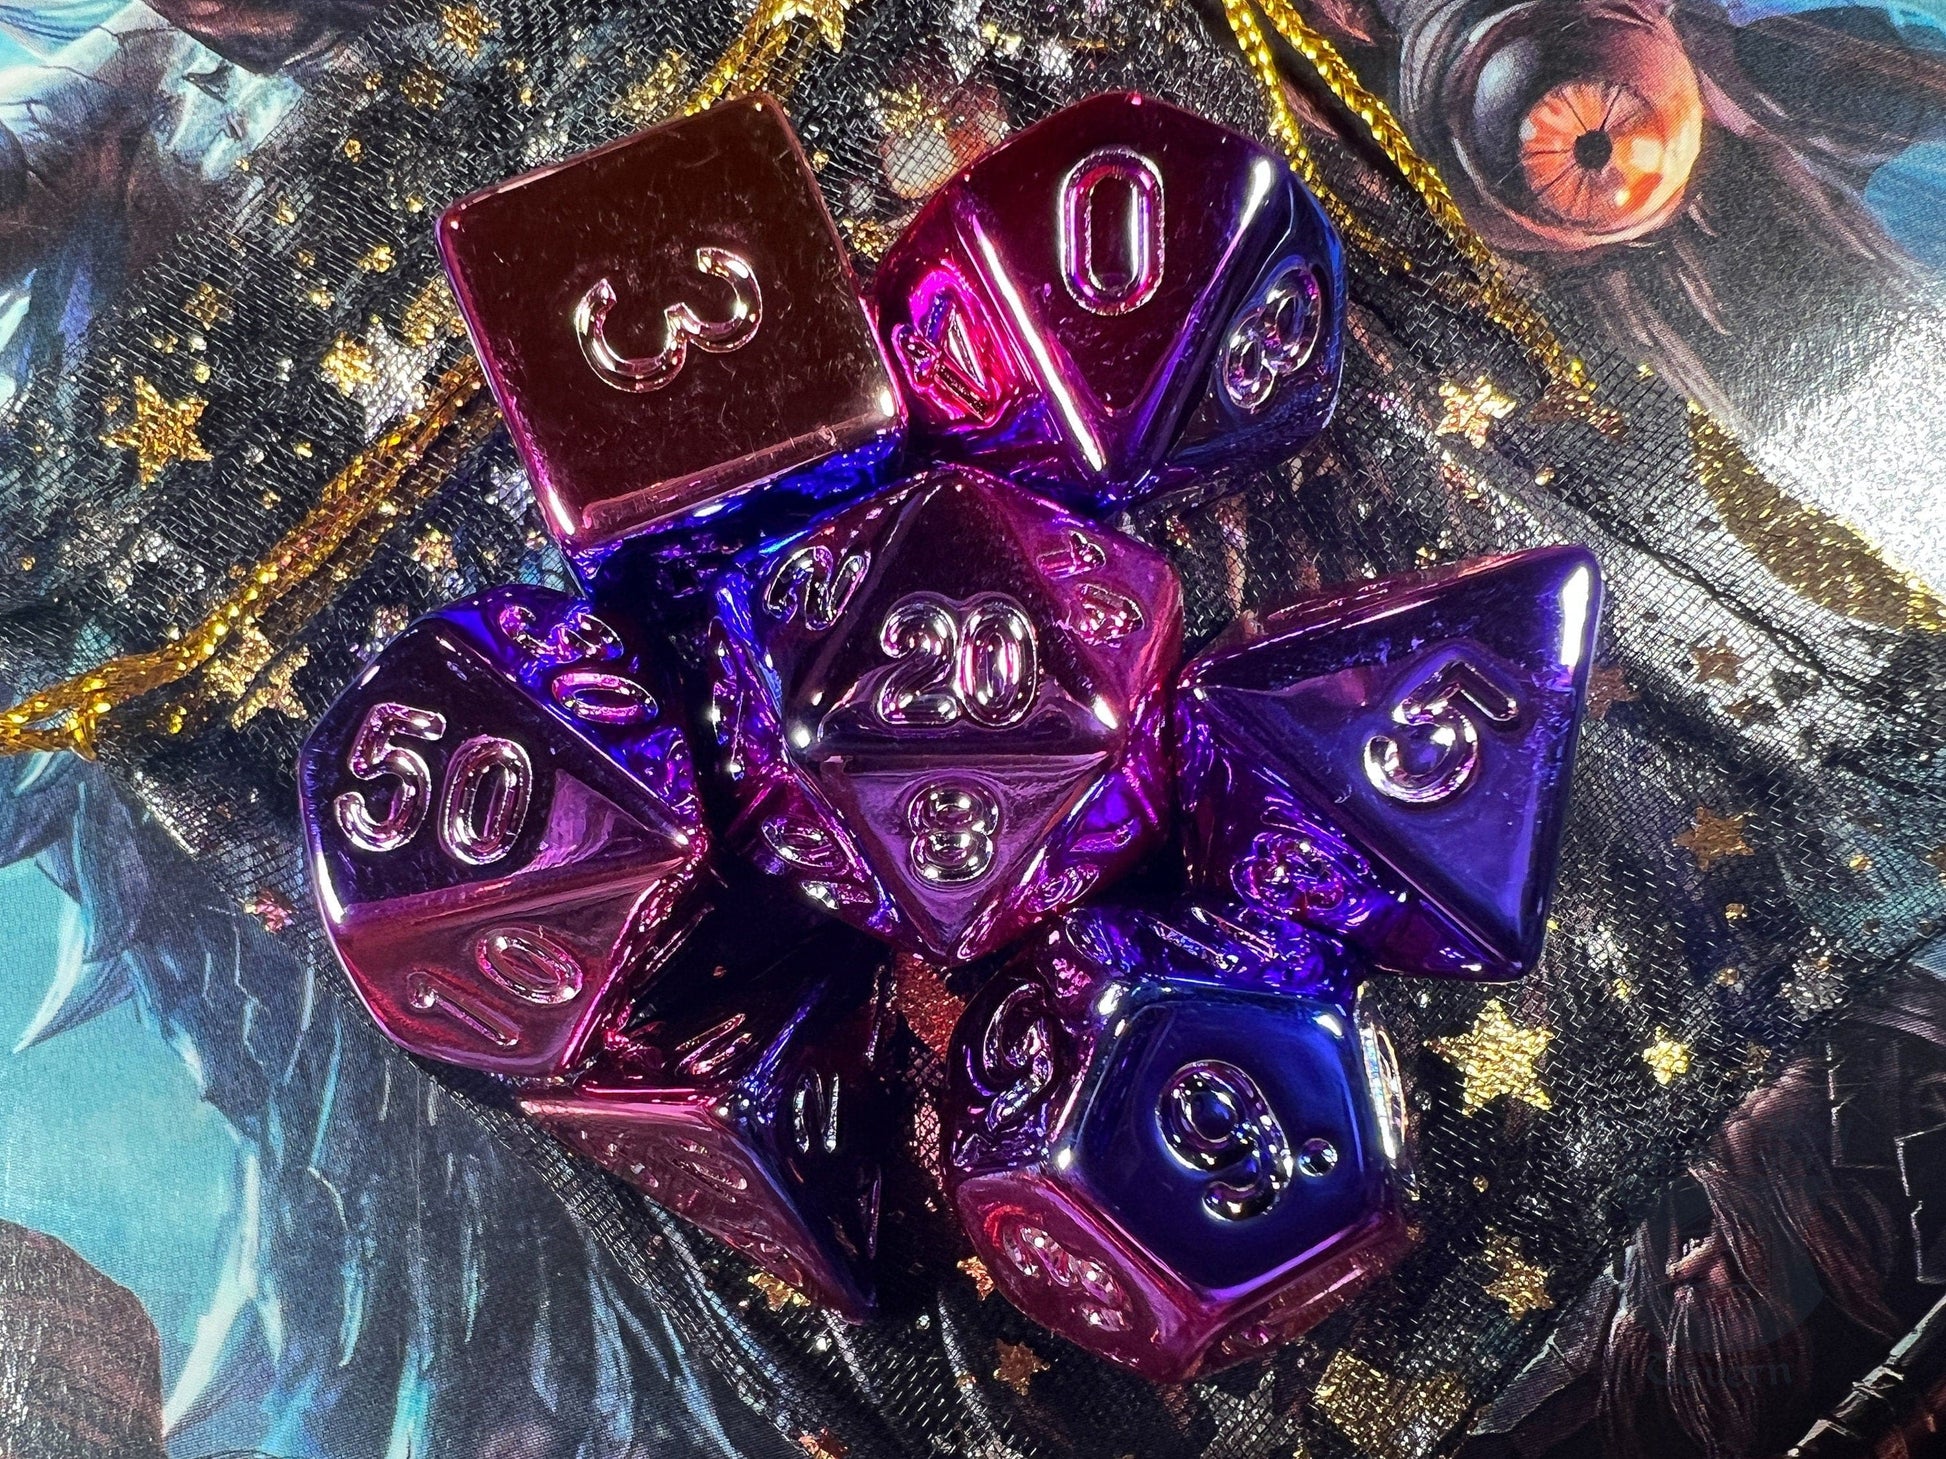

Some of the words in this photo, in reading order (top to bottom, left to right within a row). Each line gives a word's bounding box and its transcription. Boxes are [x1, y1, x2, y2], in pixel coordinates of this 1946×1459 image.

[1059, 147, 1165, 316] 0
[575, 247, 763, 393] 3
[763, 544, 869, 632] 2
[877, 599, 1038, 728] 20
[1363, 659, 1519, 803] 5
[334, 702, 532, 865] 50
[907, 787, 999, 883] 8
[408, 926, 583, 1047] 10
